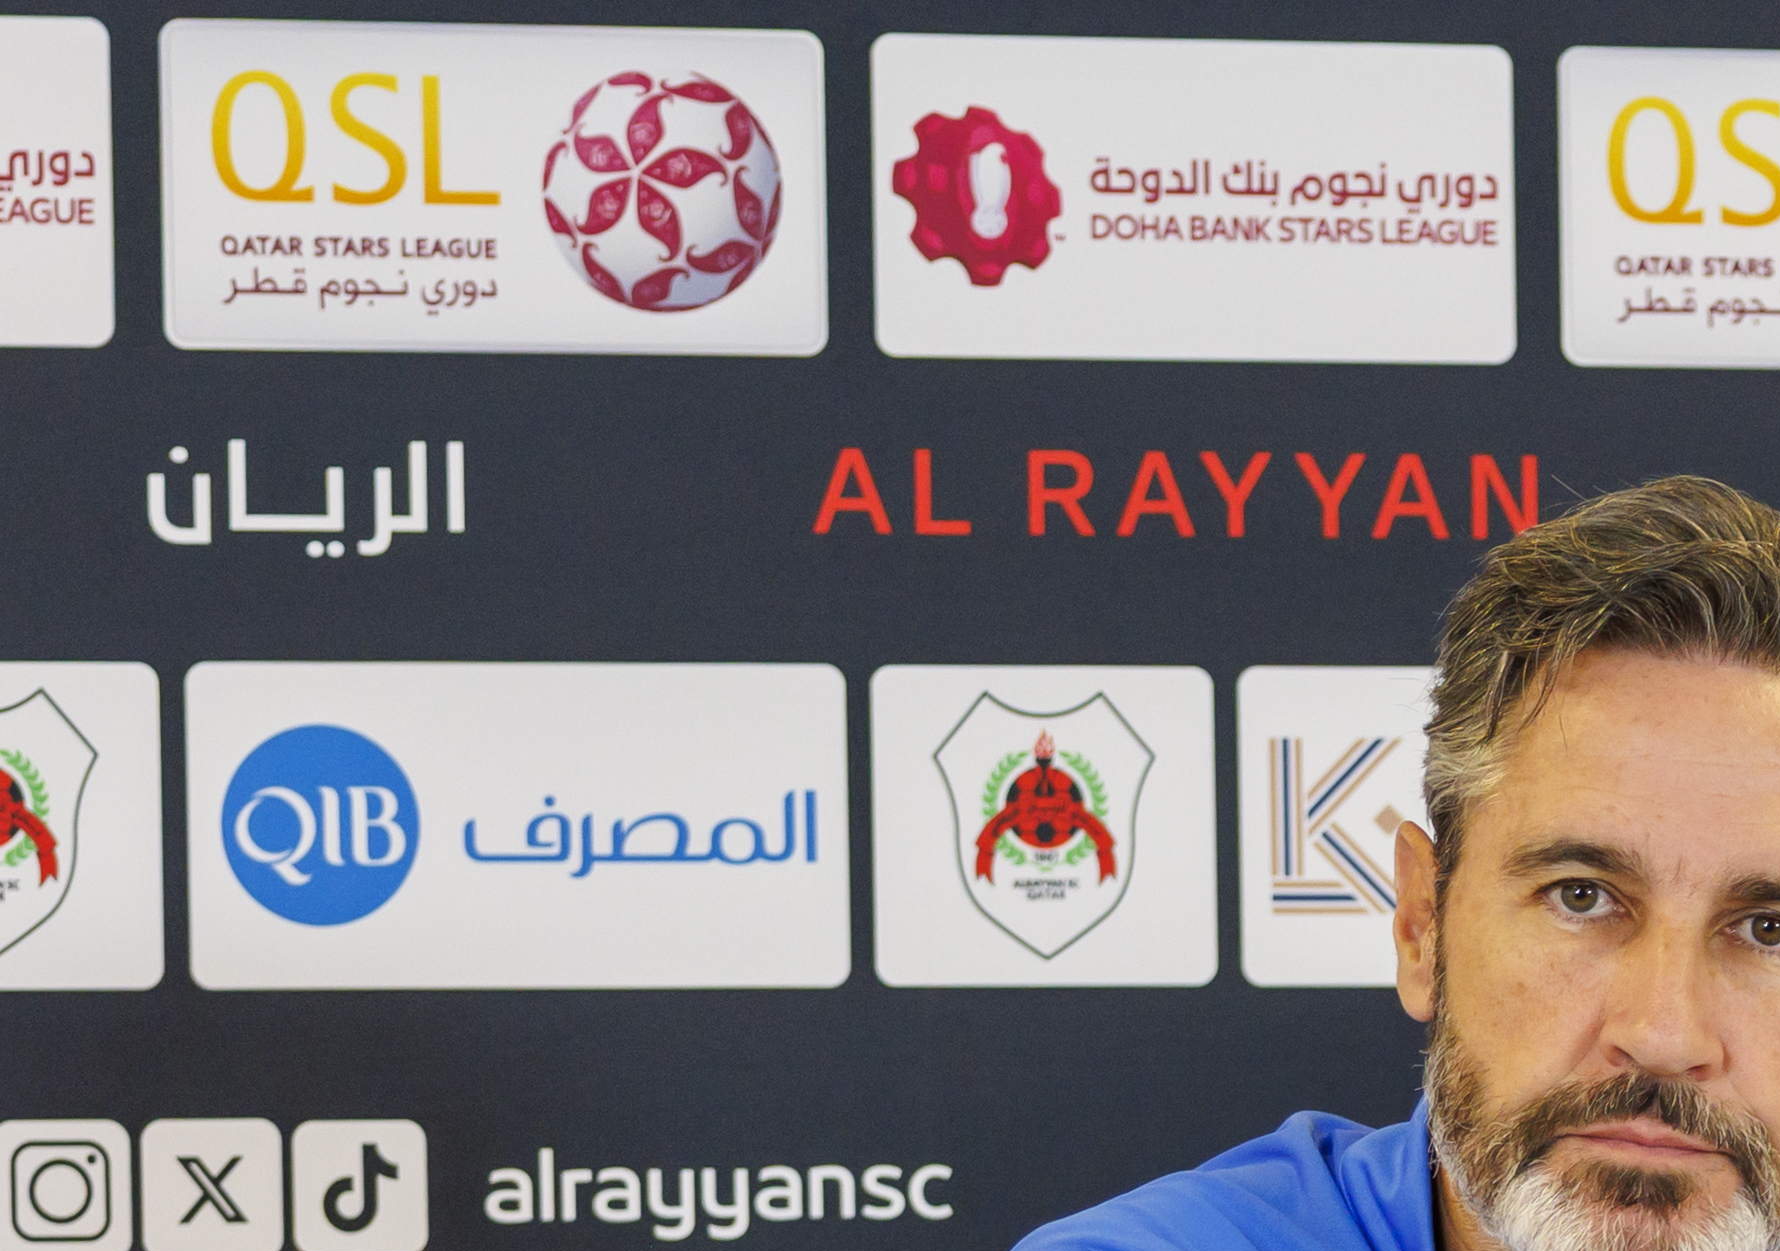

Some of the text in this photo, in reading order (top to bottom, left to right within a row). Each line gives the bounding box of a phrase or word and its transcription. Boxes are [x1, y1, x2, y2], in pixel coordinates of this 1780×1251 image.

[211, 70, 501, 206] QSL
[0, 197, 95, 224] AGUE
[1090, 158, 1498, 213] دوري نجوم بنك الدوحة
[221, 236, 495, 259] QATAR STARS LEAGUE
[1091, 214, 1496, 246] DOHA BANK STARS LEAGUE
[224, 269, 306, 304] قطر
[1617, 257, 1690, 275] QATAR
[1704, 257, 1773, 277] STARS
[422, 280, 497, 315] دوري
[147, 439, 465, 557] الريان
[814, 448, 1540, 541] AL RAYYAN
[235, 785, 407, 886] QIB
[464, 790, 817, 878] المصرف
[485, 1148, 953, 1241] alrayyansc
